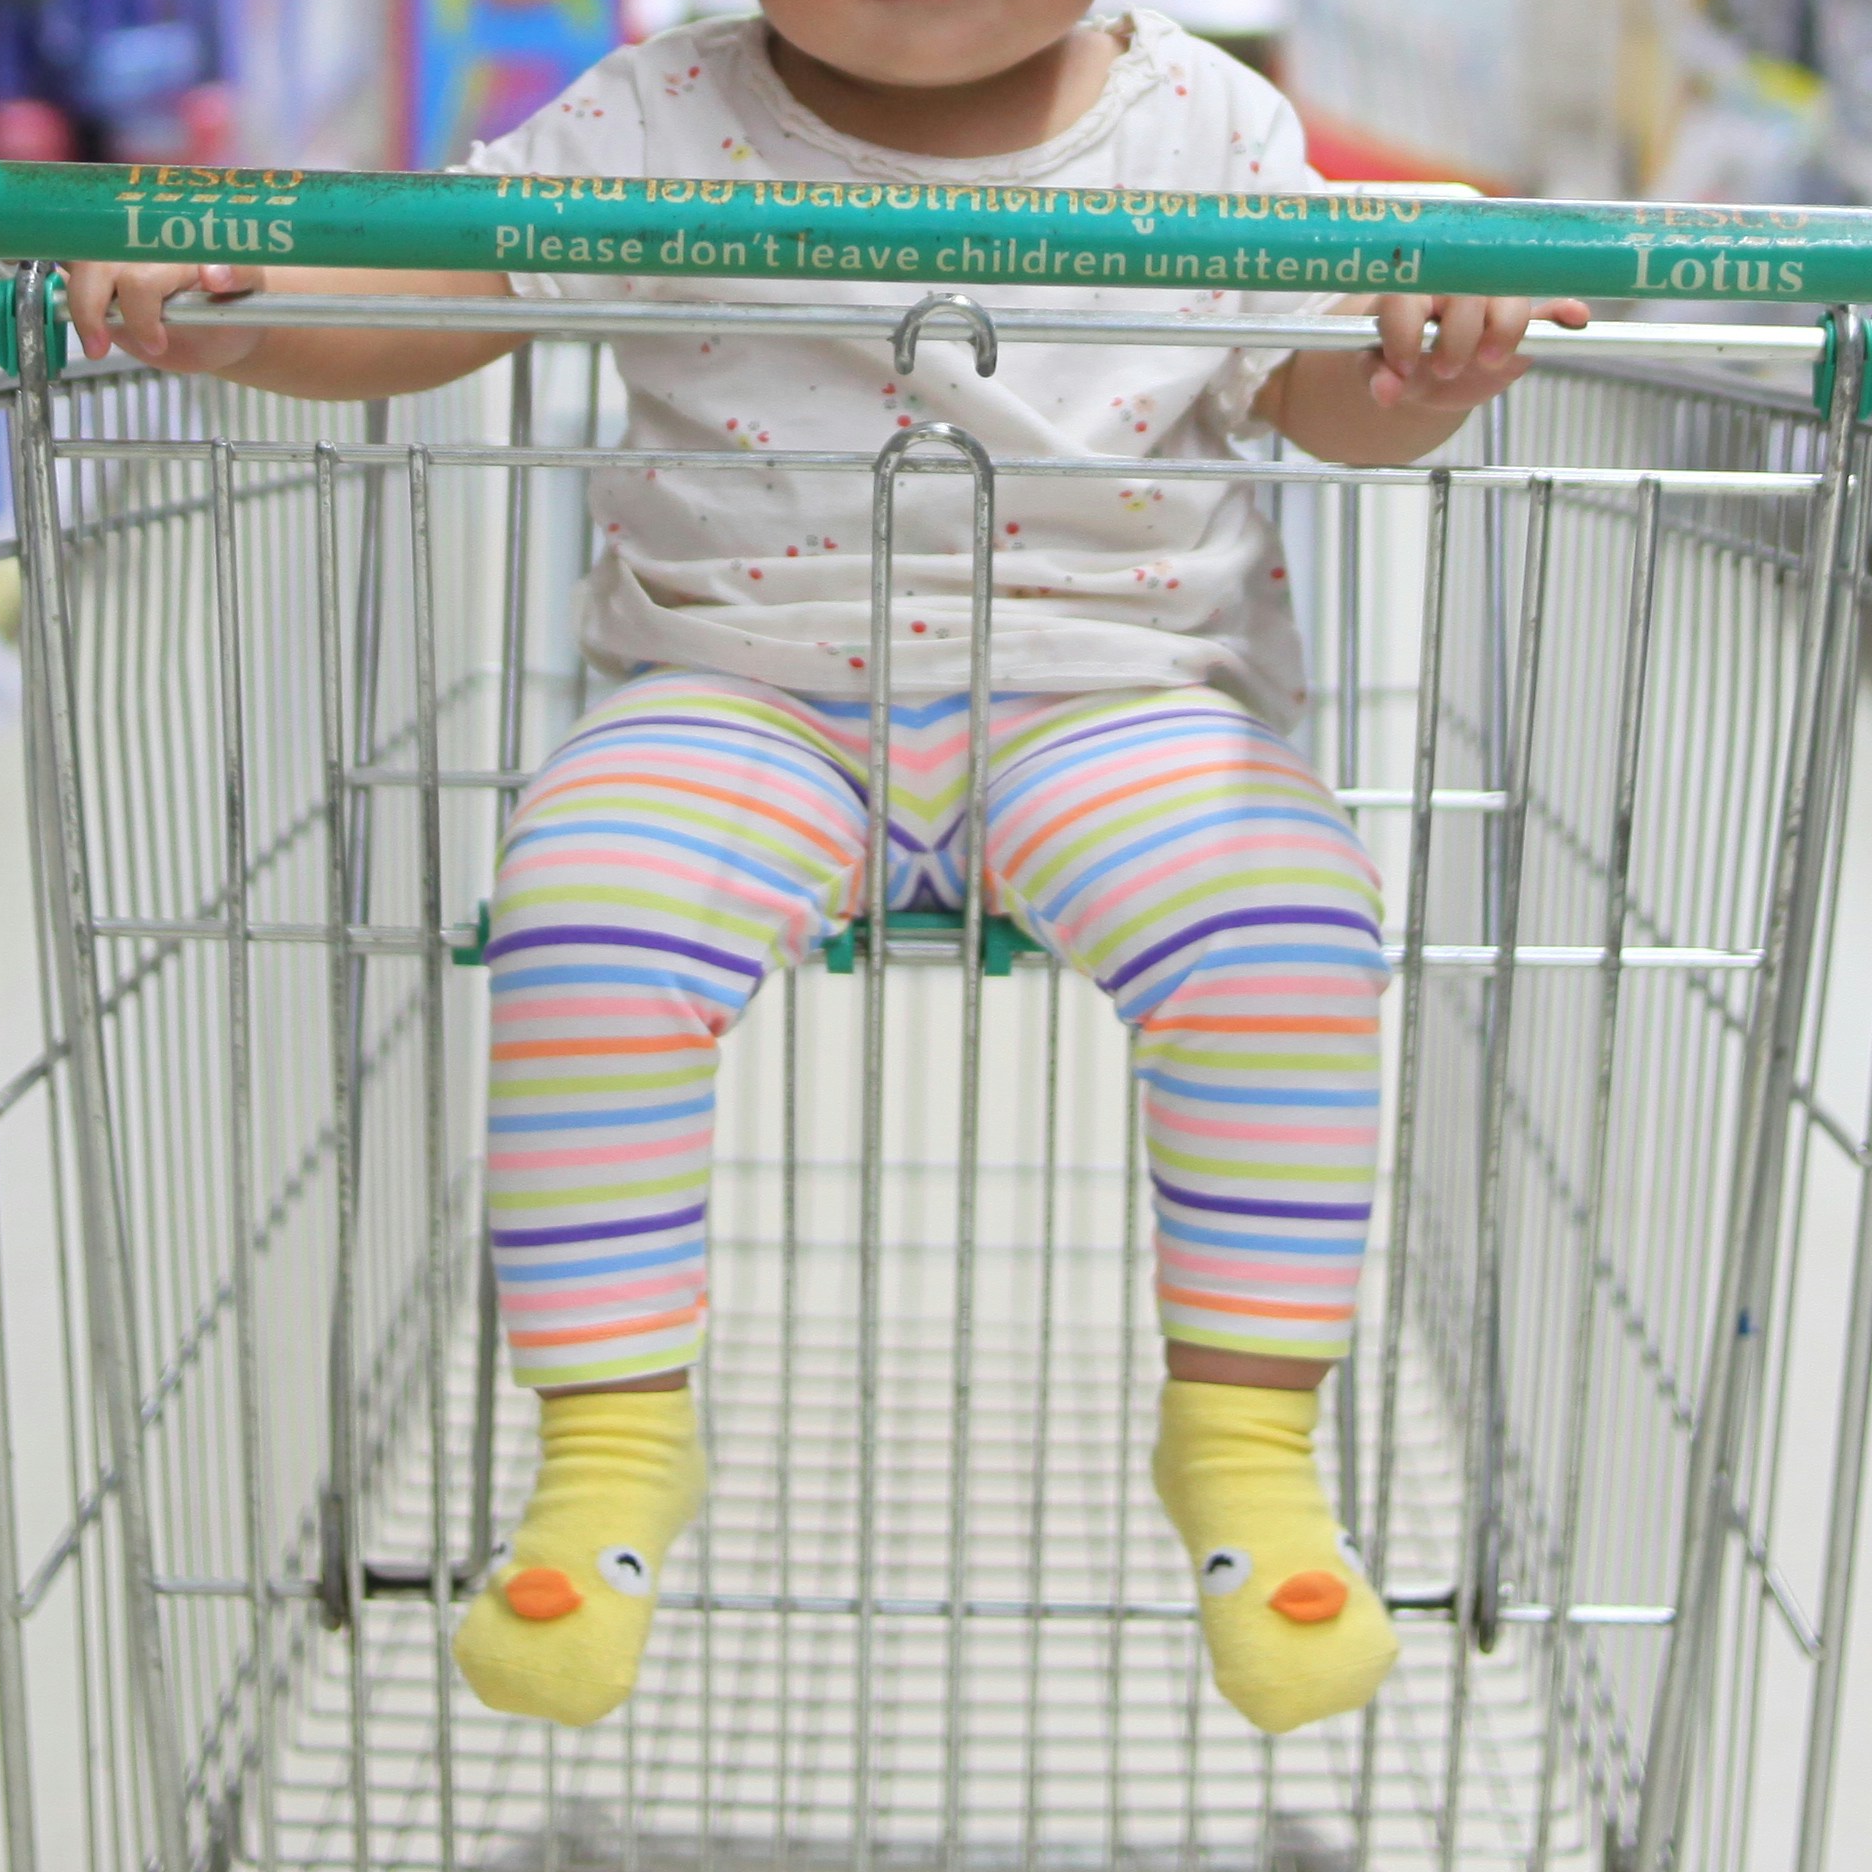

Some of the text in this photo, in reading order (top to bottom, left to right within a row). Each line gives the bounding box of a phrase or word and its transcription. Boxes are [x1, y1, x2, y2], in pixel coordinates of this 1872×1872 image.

[123, 204, 296, 253] Lotus
[495, 223, 1422, 284] Please don't leave children unattended
[1630, 242, 1805, 293] Lotus
